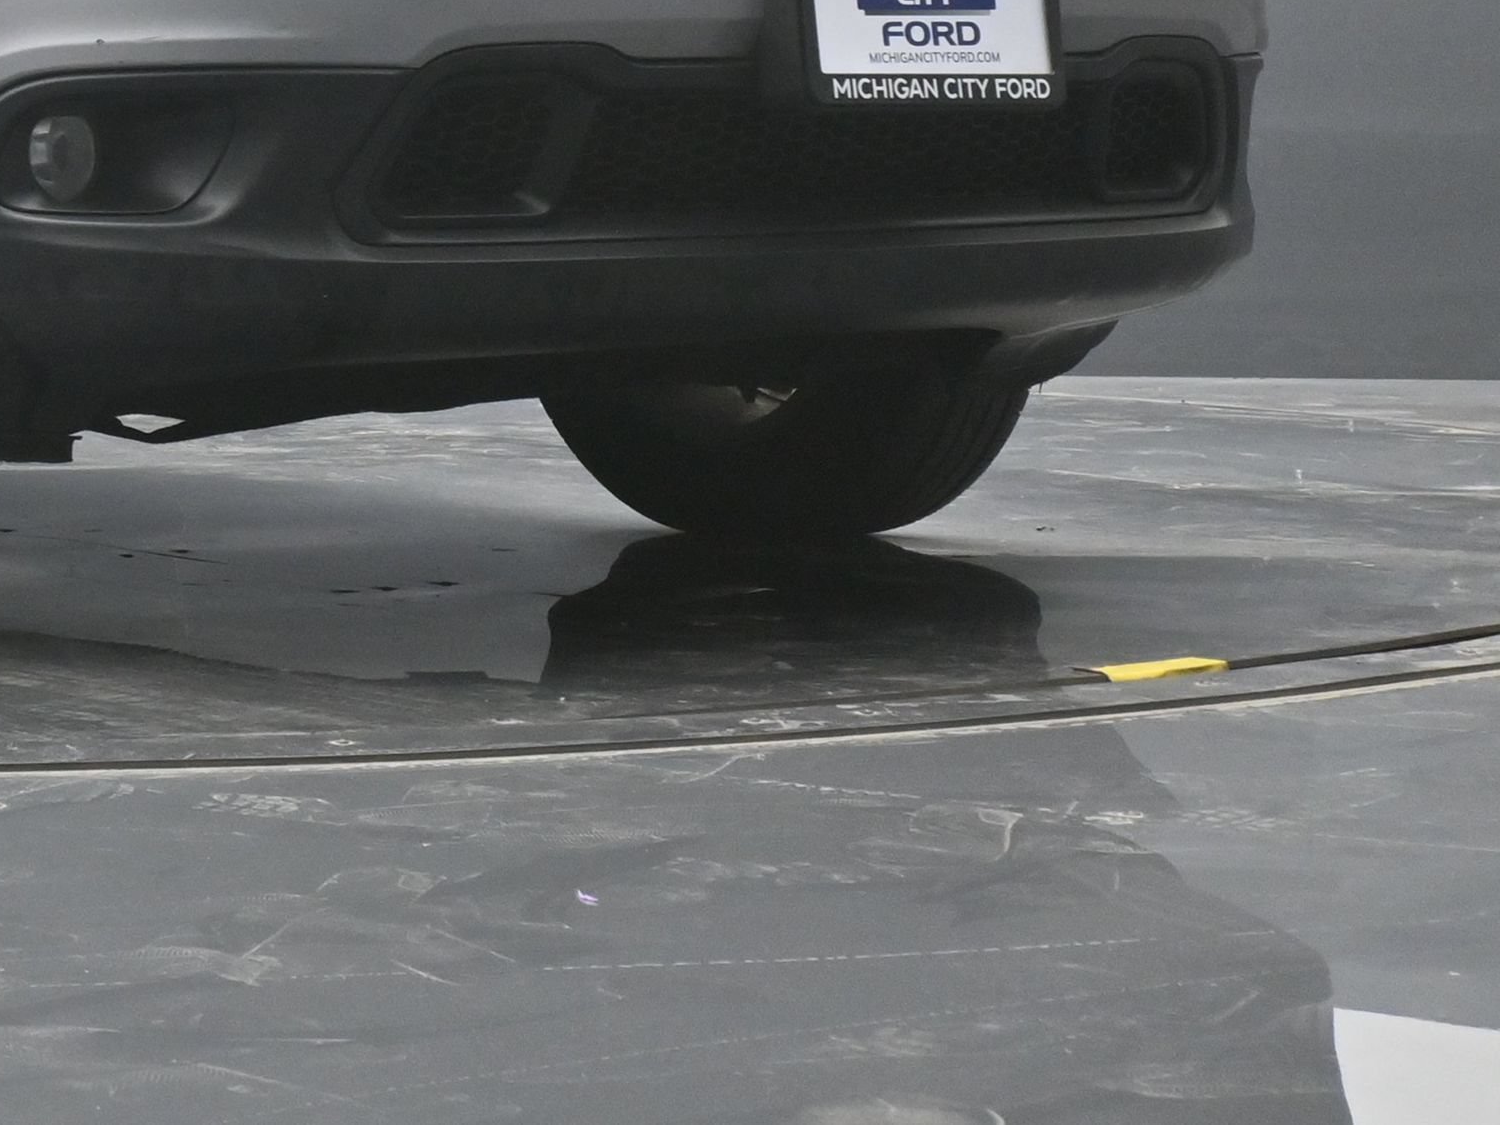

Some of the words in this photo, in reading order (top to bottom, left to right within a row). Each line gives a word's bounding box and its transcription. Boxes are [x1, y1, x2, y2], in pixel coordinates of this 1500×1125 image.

[882, 20, 982, 47] FORD
[869, 51, 1002, 65] MICHIGANCITYFORD.COM
[831, 77, 939, 100] MICHIGAN
[943, 78, 990, 100] CITY
[994, 78, 1051, 100] FORD
